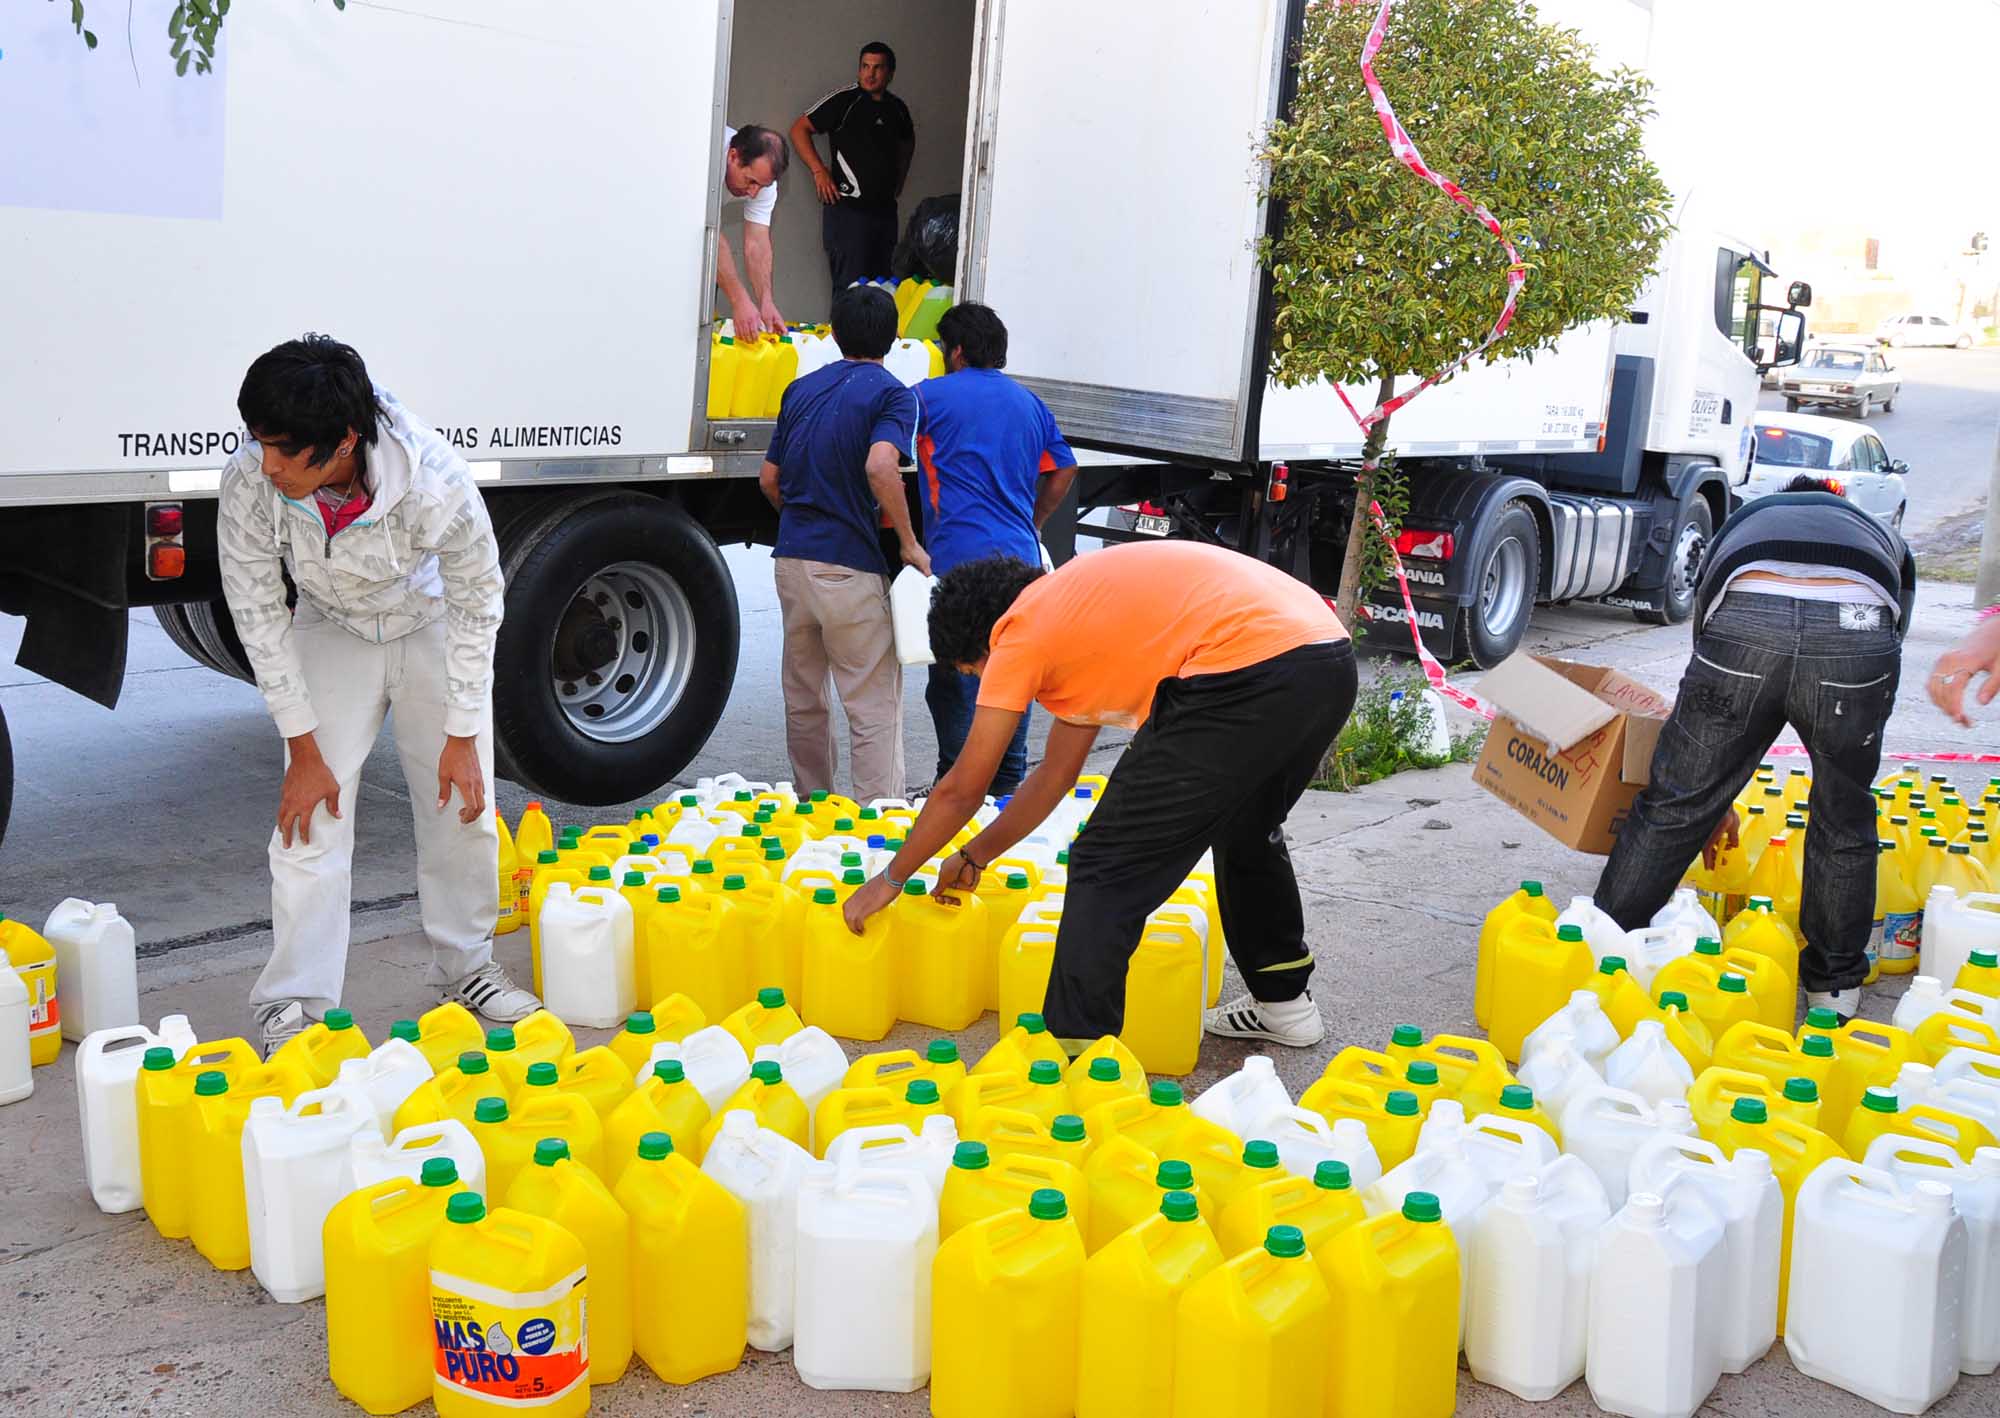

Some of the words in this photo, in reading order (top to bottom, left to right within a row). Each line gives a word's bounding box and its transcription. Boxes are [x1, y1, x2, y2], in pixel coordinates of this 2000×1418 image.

[118, 431, 245, 457] TRANSPO
[435, 427, 478, 448] IAS
[489, 425, 622, 447] ALIMENTICIAS
[1607, 596, 1652, 610] SCANIA
[1507, 737, 1569, 791] CORAZON
[434, 1318, 486, 1352] MAS
[446, 1350, 519, 1382] PURO
[533, 1376, 545, 1392] 5
